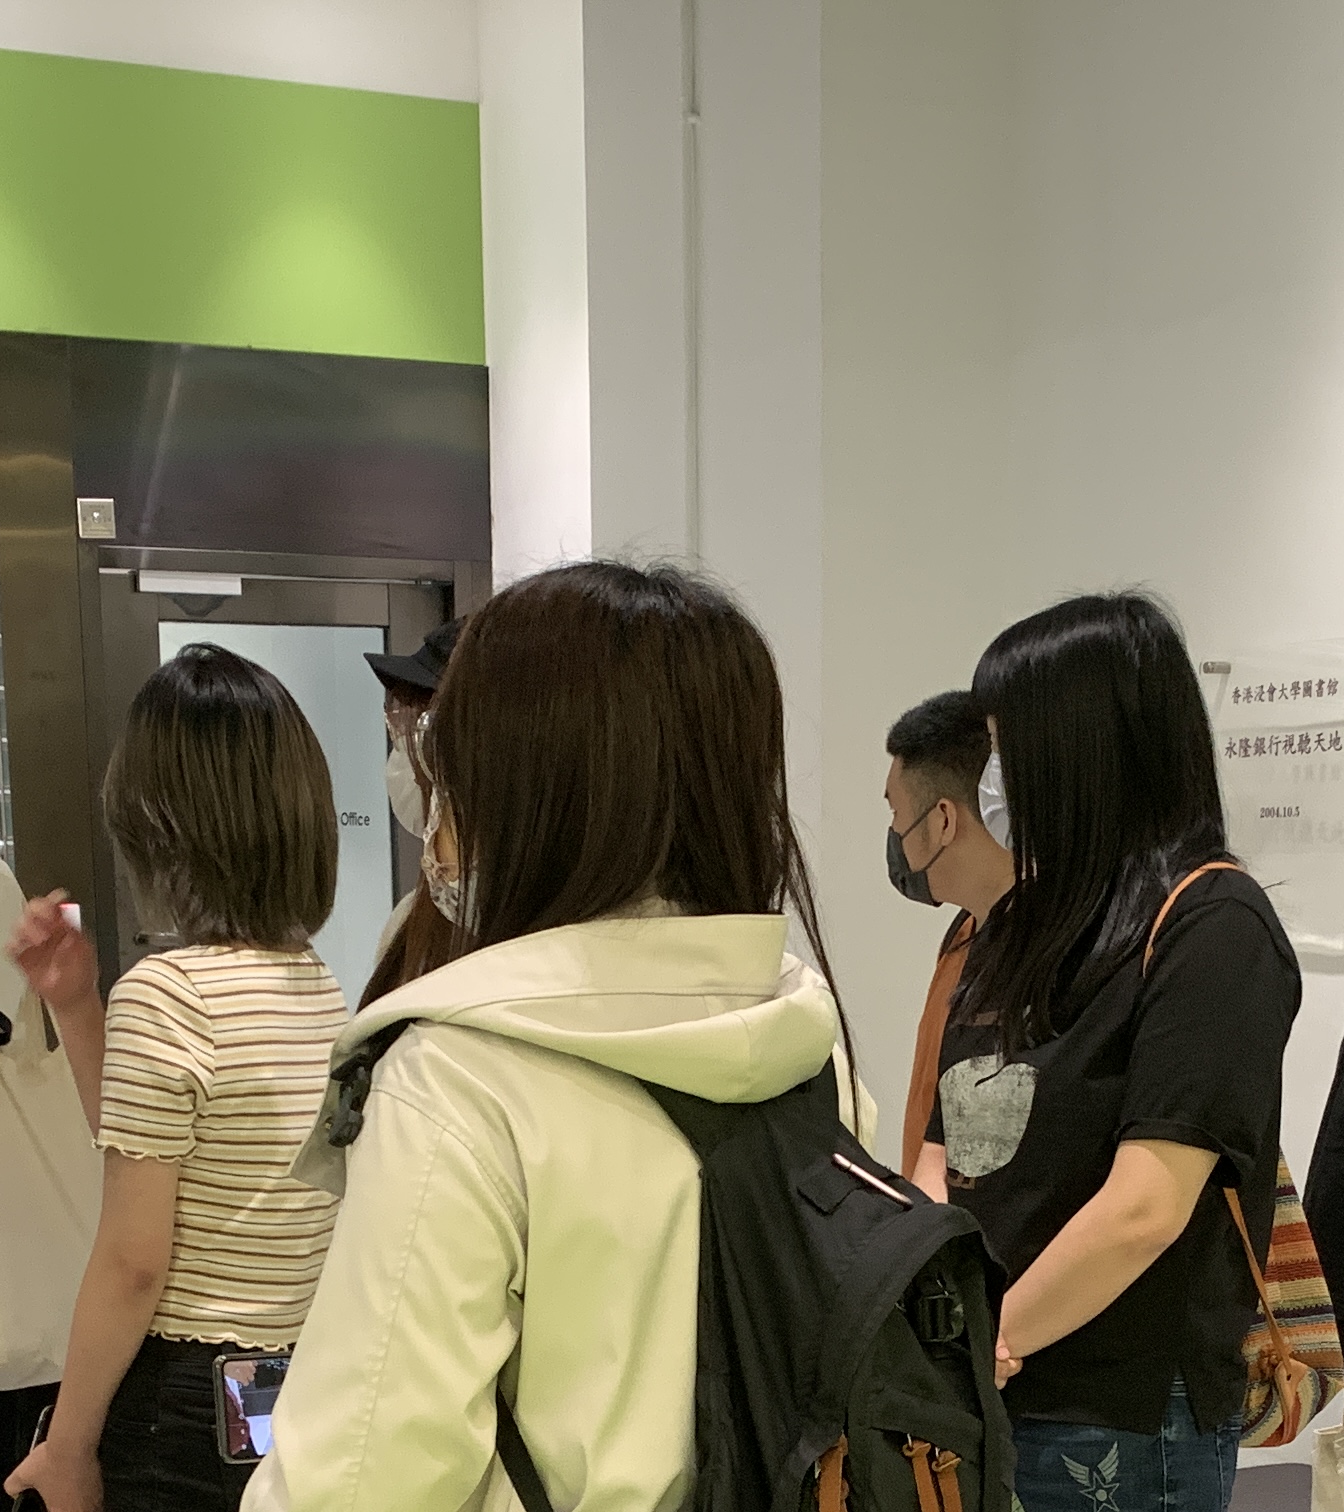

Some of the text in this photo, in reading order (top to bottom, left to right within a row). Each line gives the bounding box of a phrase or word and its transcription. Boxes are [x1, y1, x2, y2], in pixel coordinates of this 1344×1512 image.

[1224, 730, 1343, 759] 永隆銀行視聽天地
[340, 811, 371, 827] Office
